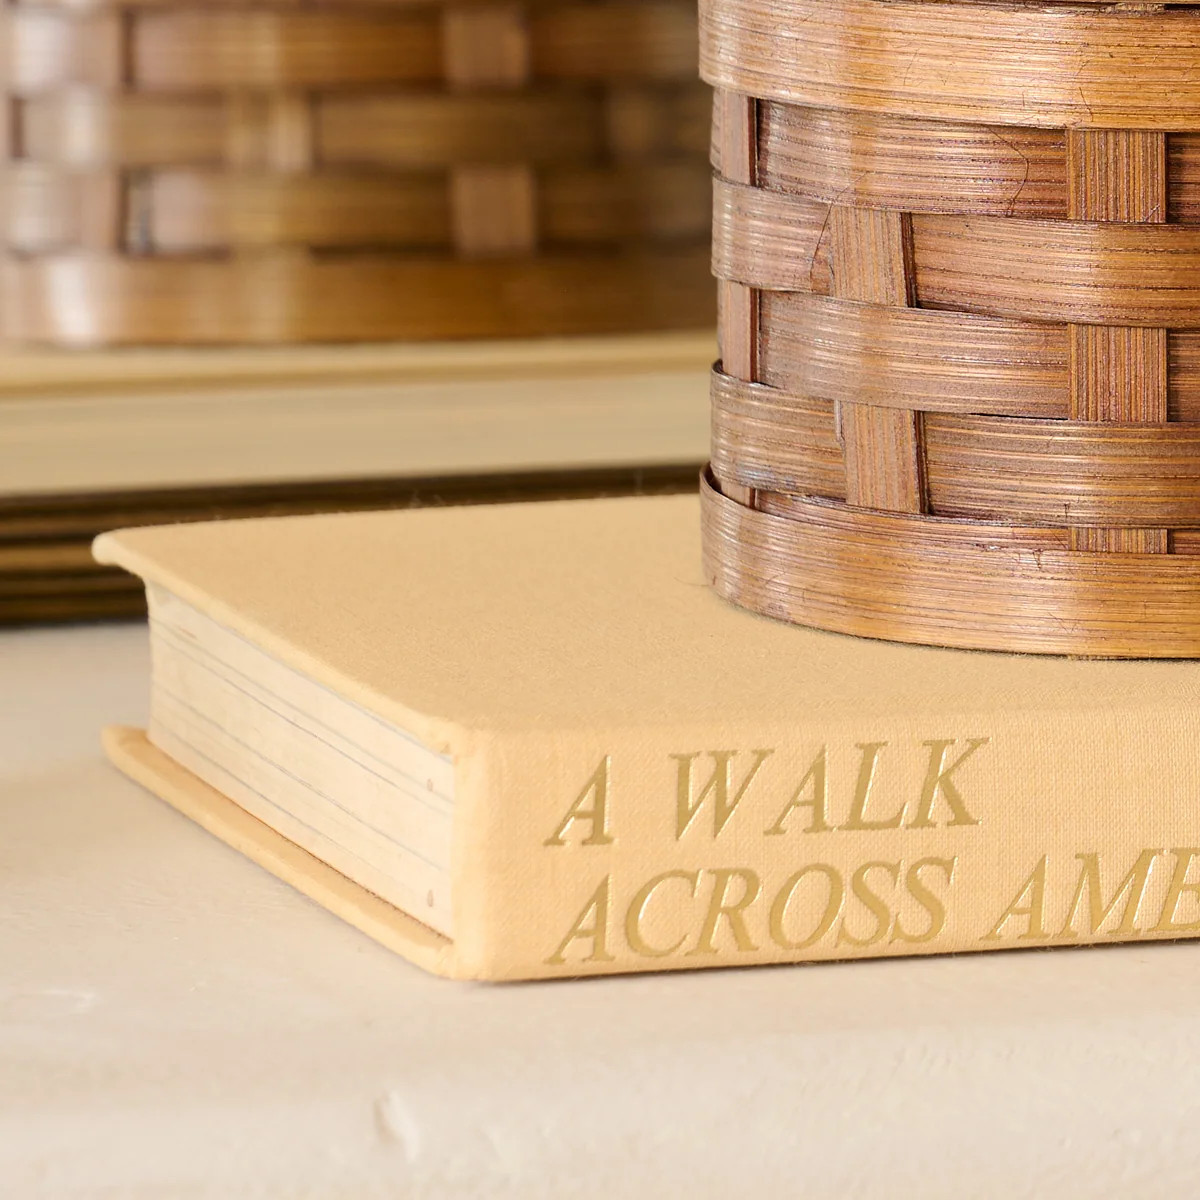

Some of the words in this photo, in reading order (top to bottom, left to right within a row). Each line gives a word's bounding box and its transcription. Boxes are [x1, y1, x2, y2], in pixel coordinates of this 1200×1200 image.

[543, 754, 615, 846] A
[668, 736, 993, 841] WALK
[543, 855, 959, 965] ACROSS
